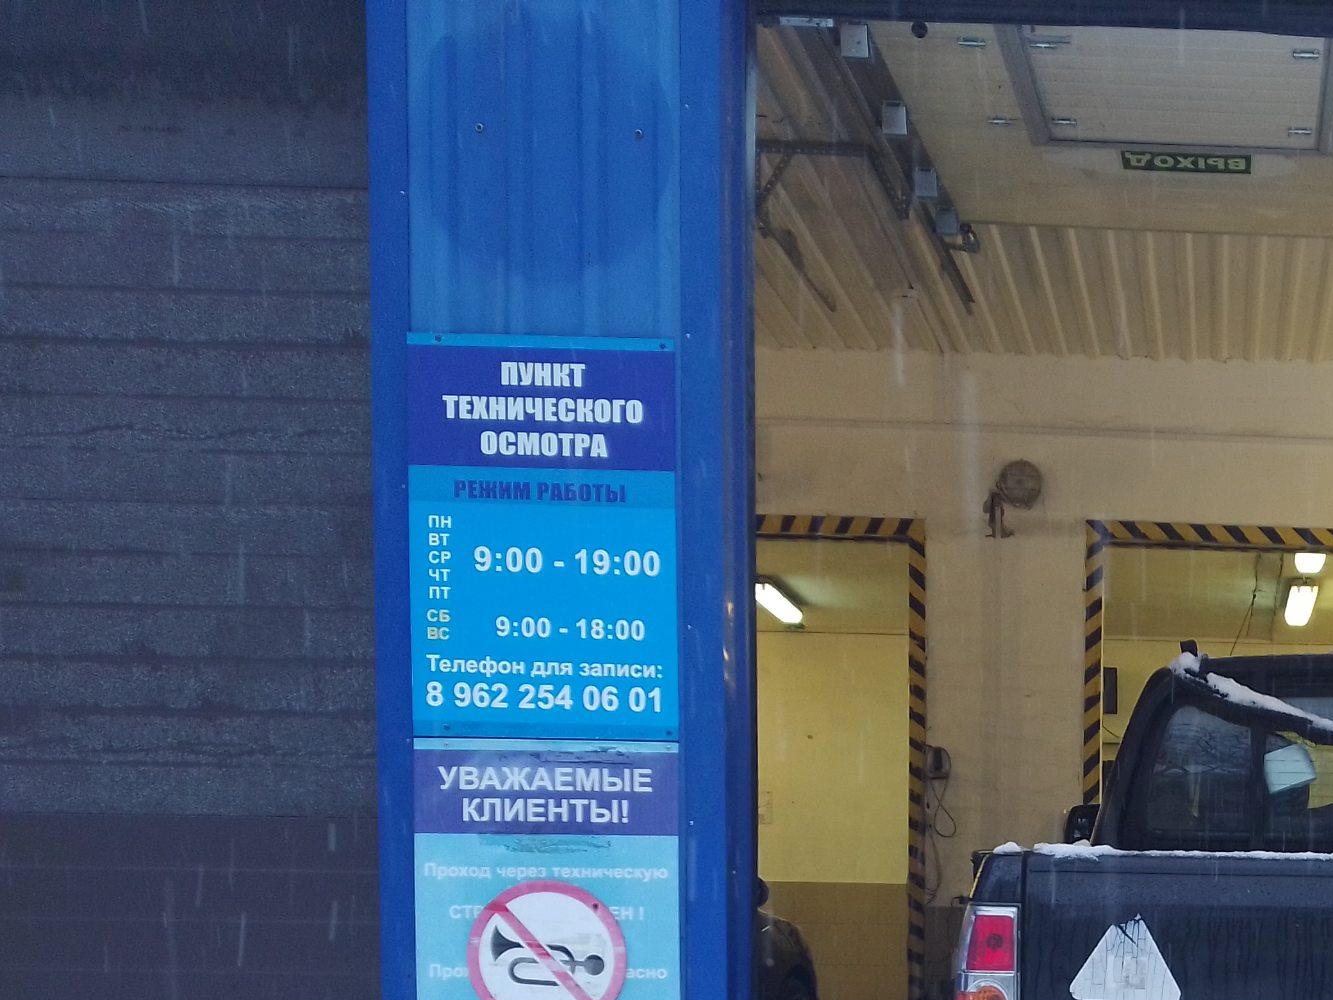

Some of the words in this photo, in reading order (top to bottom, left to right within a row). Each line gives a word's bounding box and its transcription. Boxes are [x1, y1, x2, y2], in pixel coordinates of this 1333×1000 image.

[1124, 151, 1246, 170] ВЫХОД
[500, 361, 586, 388] ПУНКТ
[442, 394, 643, 424] ТЕХНИЧЕСКОГО
[479, 430, 608, 458] ОСМОТРА
[453, 479, 531, 501] РЕЖИМ
[536, 480, 627, 503] РАБОТЫ
[428, 514, 452, 529] ПН
[428, 532, 450, 546] ВТ
[428, 550, 452, 564] СР
[473, 545, 543, 574] 9:00
[574, 548, 661, 577] 19:00
[428, 568, 451, 582] ЧТ
[428, 586, 452, 600] ПТ
[426, 608, 451, 623] СБ
[426, 626, 450, 641] ВС
[495, 615, 551, 639] 9:00
[575, 618, 645, 641] 18:00
[425, 654, 526, 679] Телефон
[530, 661, 573, 679] для
[579, 661, 663, 679] записи:
[425, 681, 443, 707] 8
[453, 682, 509, 709] 962
[518, 684, 573, 711] 254
[582, 685, 620, 712] 06
[625, 686, 662, 713] 01
[437, 765, 653, 793] УВАЖАЕМЫЕ
[462, 797, 630, 824] КЛИЕНТЫ!
[424, 862, 491, 880] Проход
[497, 865, 546, 880] через
[553, 866, 669, 882] техническую
